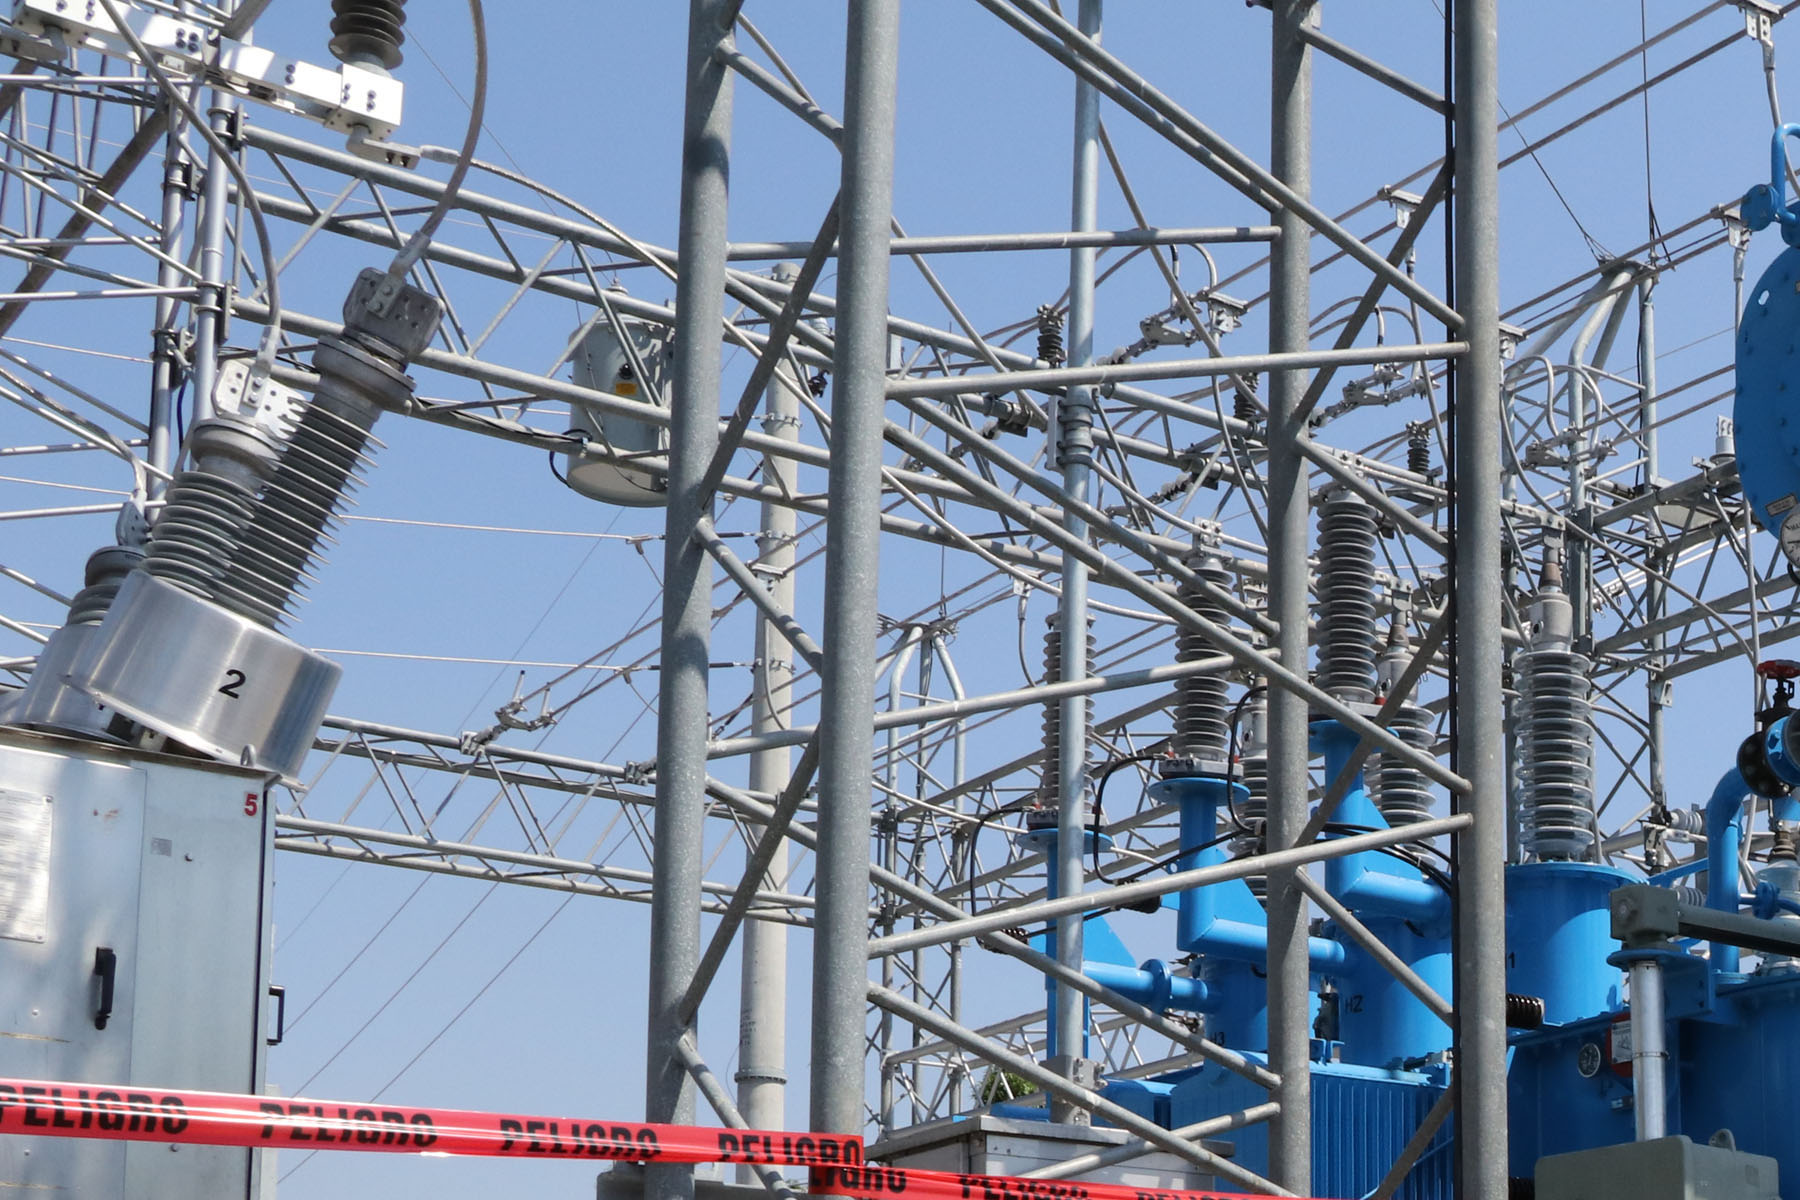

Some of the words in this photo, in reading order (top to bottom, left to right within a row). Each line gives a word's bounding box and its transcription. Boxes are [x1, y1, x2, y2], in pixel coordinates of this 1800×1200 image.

[218, 669, 246, 699] 2
[244, 793, 258, 816] 5
[258, 1103, 439, 1148] PELIGRO
[500, 1118, 662, 1159] PELIGRO
[717, 1132, 861, 1168] PELIGRO
